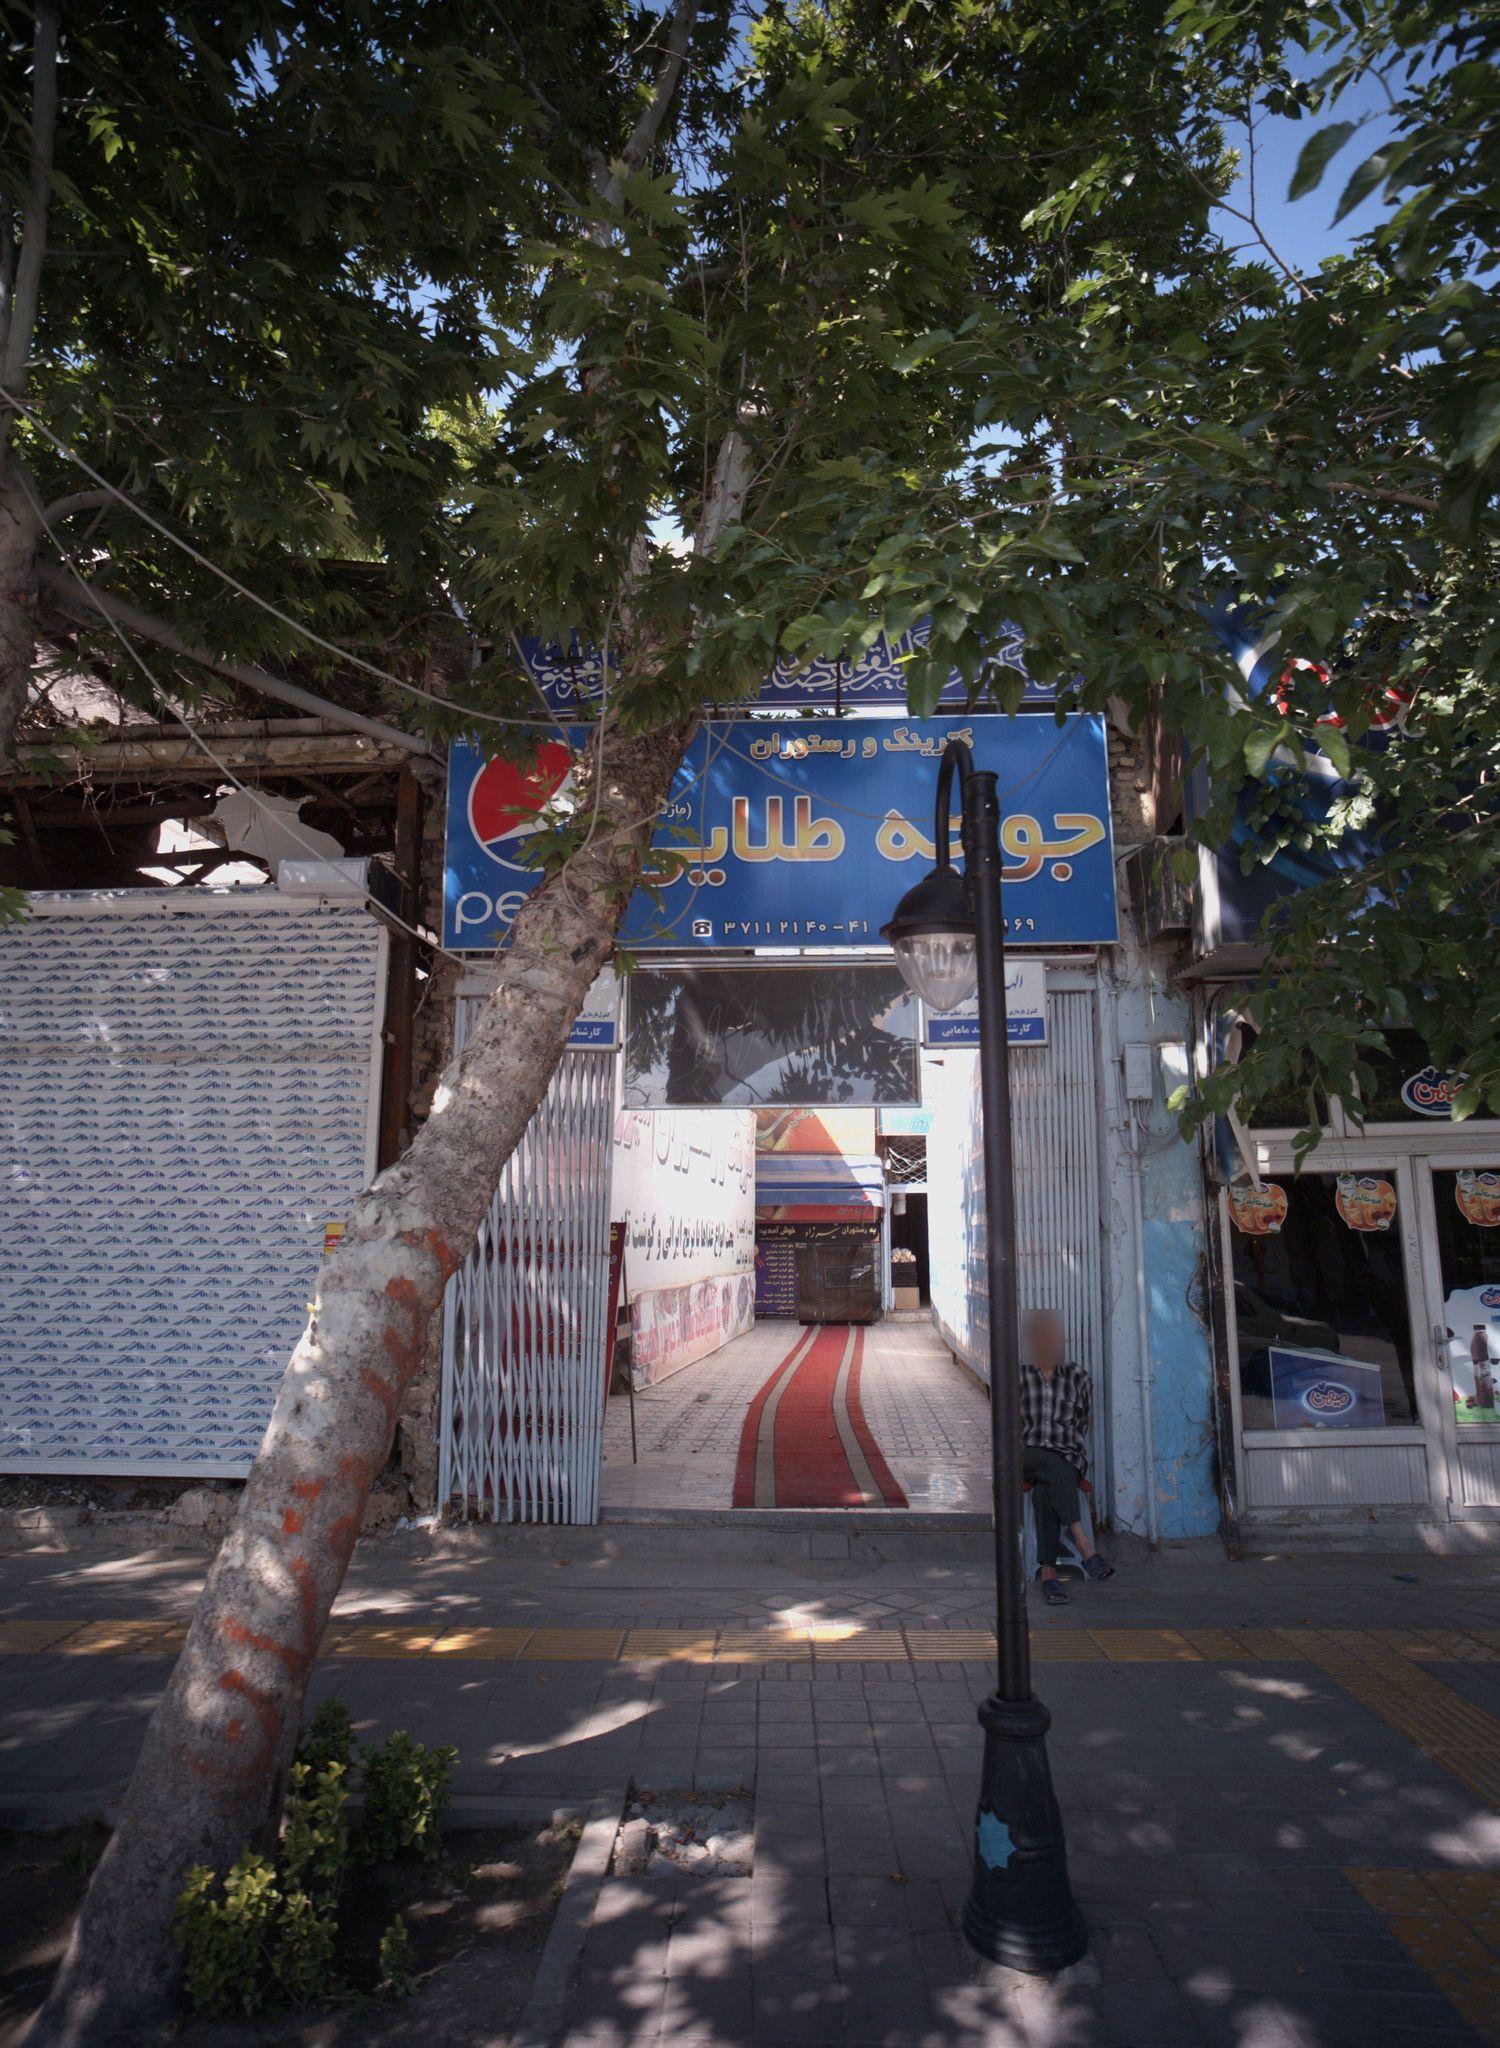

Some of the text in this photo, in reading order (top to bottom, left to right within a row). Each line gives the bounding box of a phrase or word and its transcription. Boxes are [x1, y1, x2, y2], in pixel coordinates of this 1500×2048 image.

[750, 732, 857, 760] رستوران
[862, 737, 875, 758] و
[941, 1026, 970, 1038] مامایی
[1309, 1389, 1350, 1409] میهن
